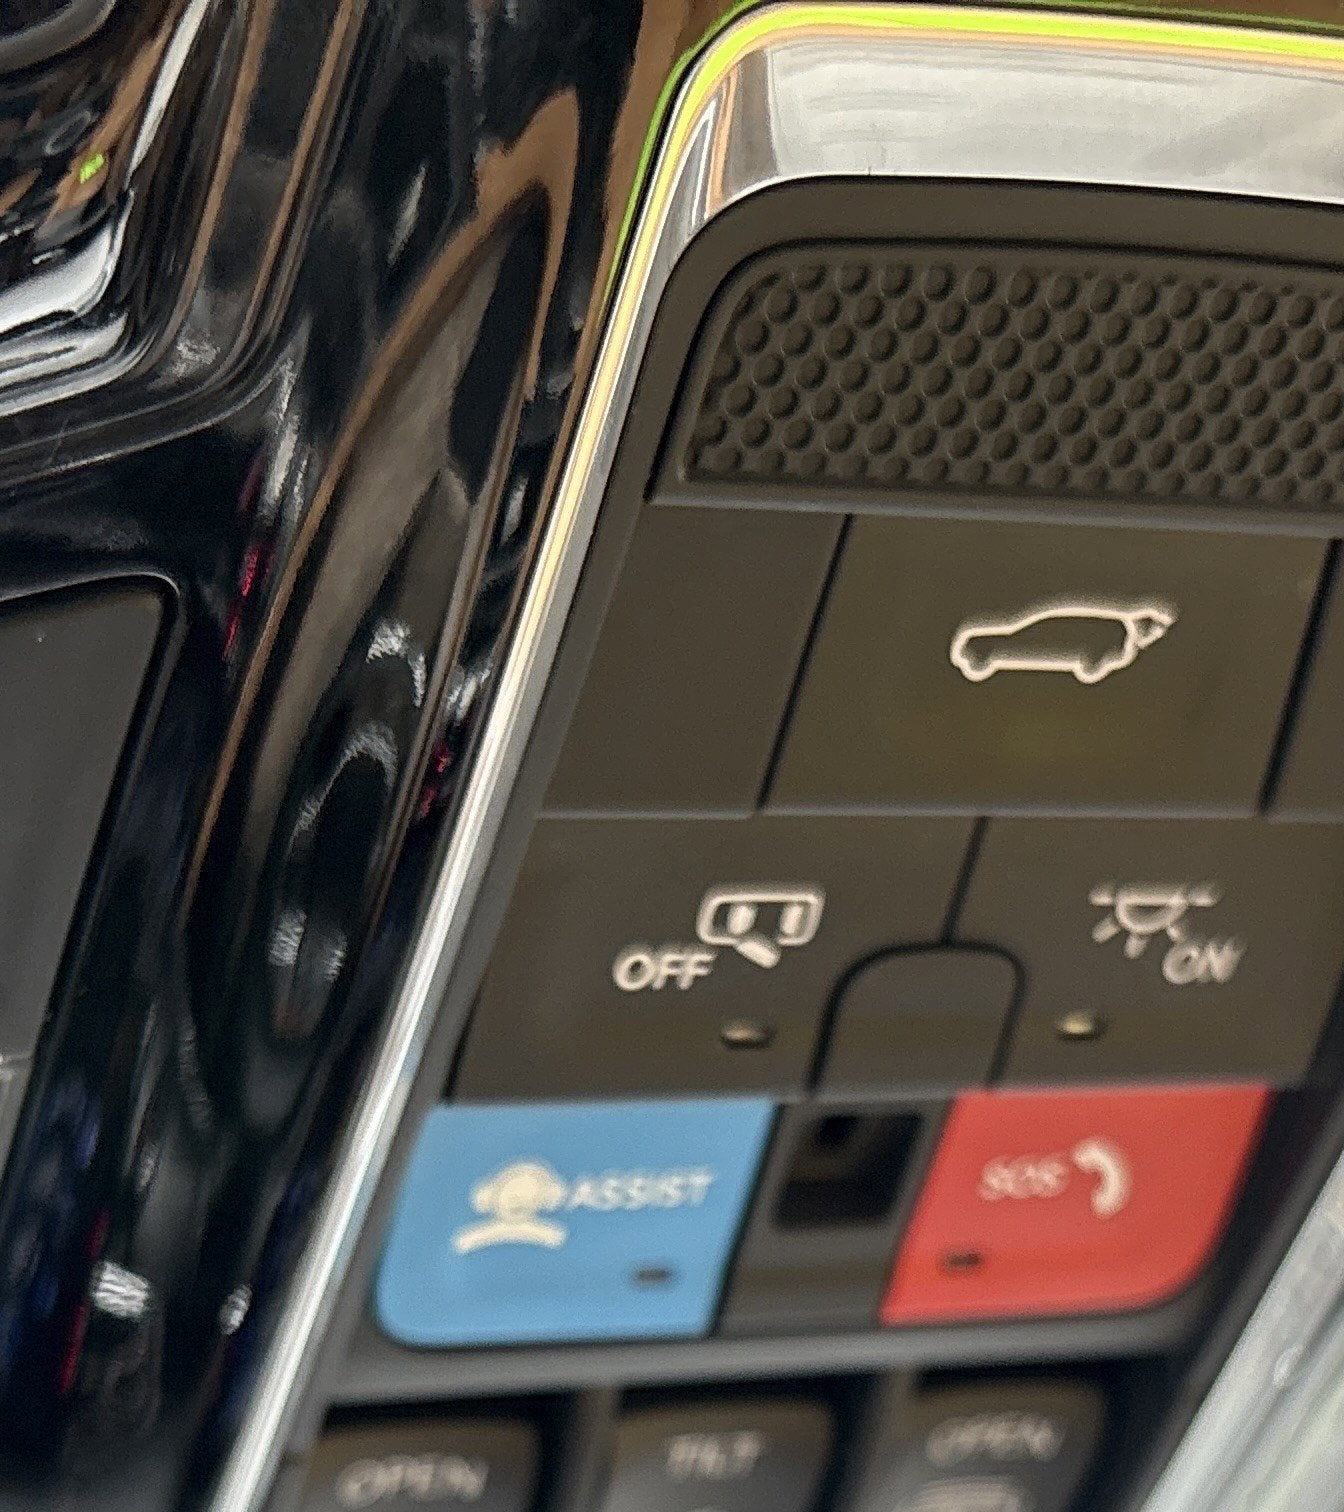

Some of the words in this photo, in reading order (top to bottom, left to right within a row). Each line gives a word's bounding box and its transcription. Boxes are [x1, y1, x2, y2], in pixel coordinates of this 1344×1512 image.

[611, 943, 717, 992] OFF
[1161, 939, 1244, 985] ON
[565, 1166, 714, 1210] ASSIST
[977, 1153, 1069, 1202] SOS
[337, 1453, 489, 1508] OPEN
